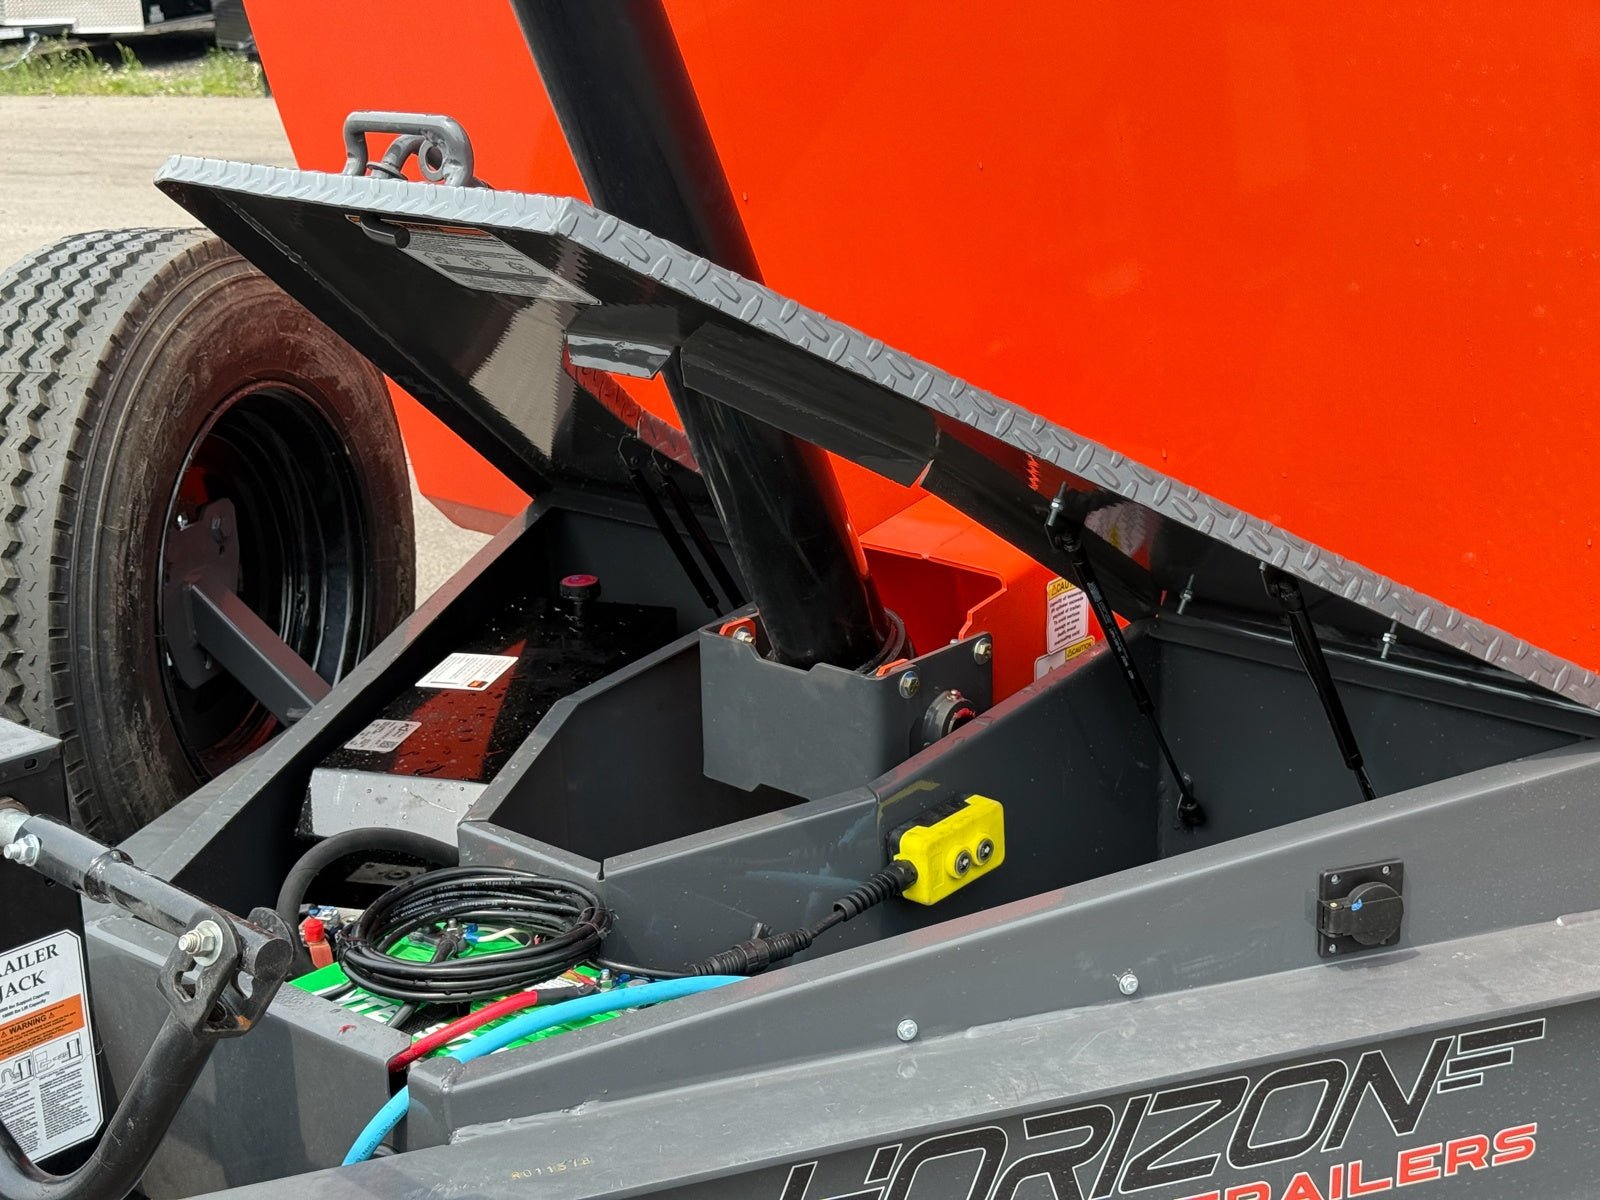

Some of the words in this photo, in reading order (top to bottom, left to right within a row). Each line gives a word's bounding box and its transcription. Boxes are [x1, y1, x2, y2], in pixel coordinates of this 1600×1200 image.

[0, 943, 59, 978] AILER
[0, 969, 46, 1004] JACK
[9, 1014, 47, 1034] WARNING
[1174, 1122, 1538, 1200] RAILERS
